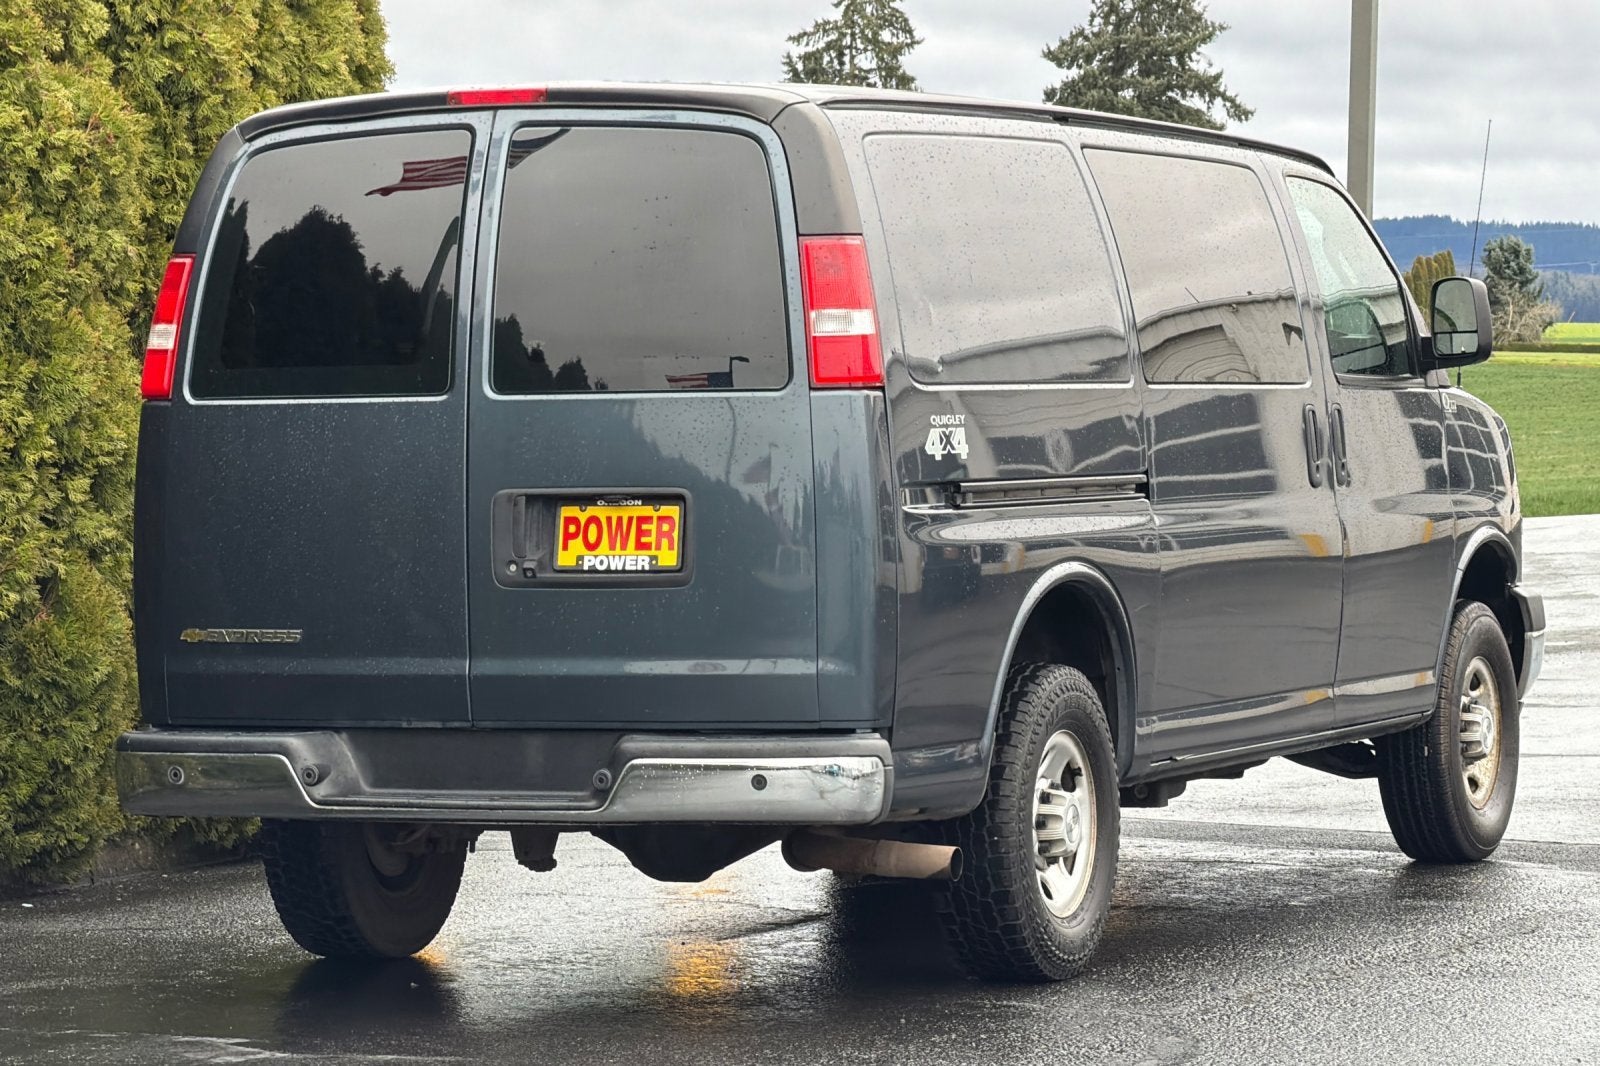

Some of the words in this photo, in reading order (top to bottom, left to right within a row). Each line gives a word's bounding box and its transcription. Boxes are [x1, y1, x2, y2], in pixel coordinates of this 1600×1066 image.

[930, 414, 966, 427] QUIGLEY
[925, 427, 969, 460] 4X4
[562, 515, 676, 551] POWER
[583, 555, 649, 571] POWER
[206, 628, 302, 642] EXPRESS
